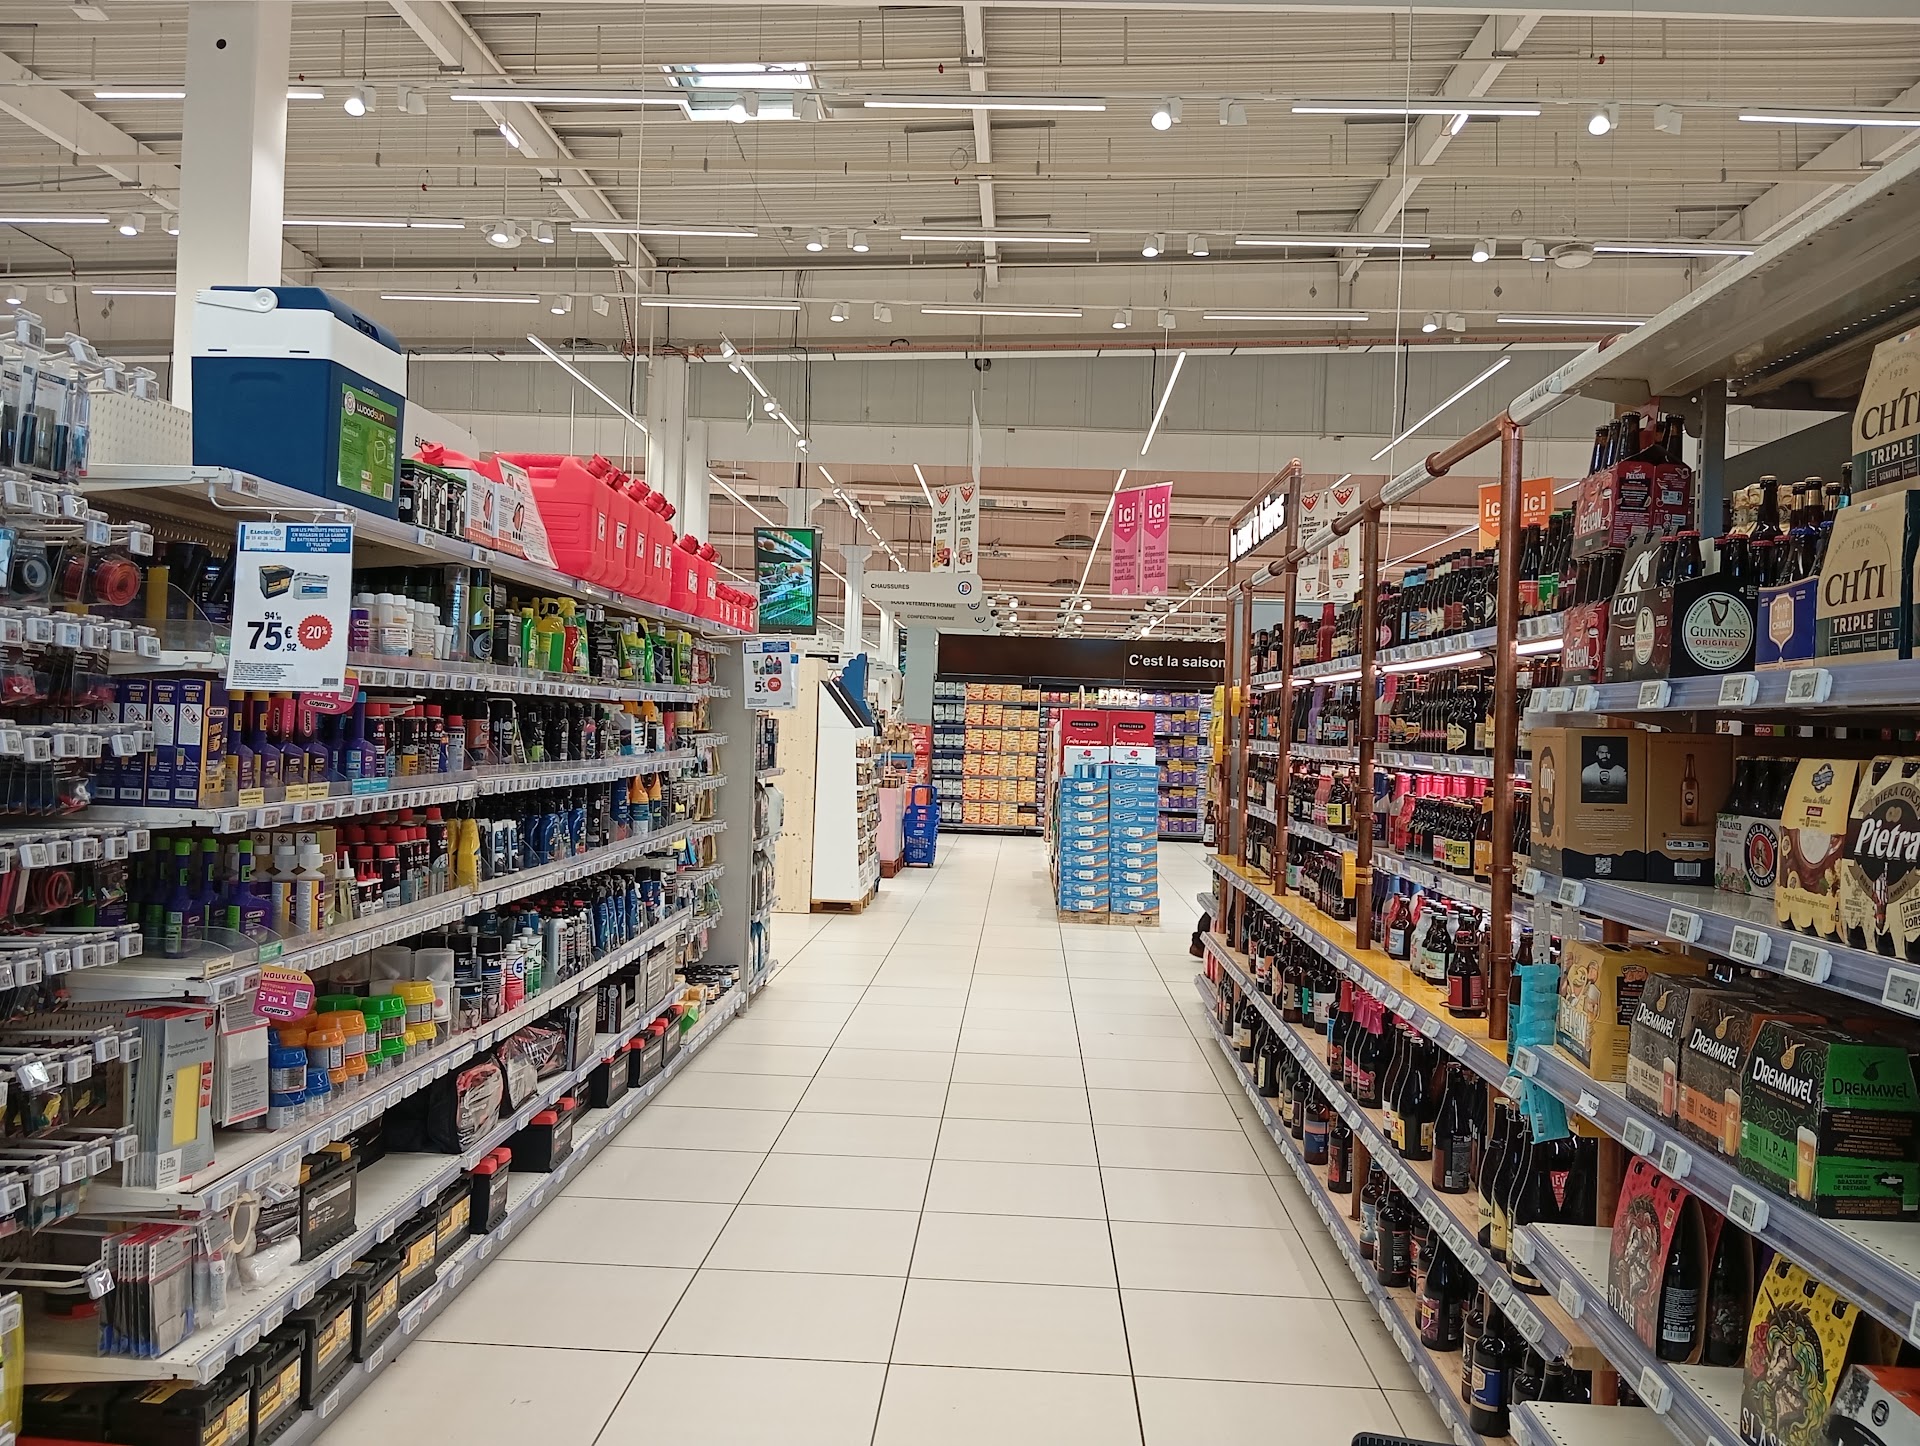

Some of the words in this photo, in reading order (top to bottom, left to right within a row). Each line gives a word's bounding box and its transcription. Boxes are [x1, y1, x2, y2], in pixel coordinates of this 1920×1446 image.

[1889, 364, 1909, 380] 1926
[356, 403, 385, 423] woodsun
[1871, 439, 1914, 467] TRIPLE
[1879, 467, 1901, 482] SIGNATURE
[1149, 498, 1165, 519] ici
[1523, 491, 1547, 513] ici
[1118, 502, 1136, 523] ici
[1851, 537, 1871, 550] 1926
[1690, 625, 1746, 639] GUINNESS
[1833, 612, 1874, 634] TRIPLE
[1695, 639, 1739, 647] ORIGINAL
[1841, 639, 1861, 650] SIGNATURE
[1128, 654, 1164, 667] C'est
[1166, 655, 1179, 667] la
[1182, 656, 1226, 668] saison
[209, 721, 224, 735] FORCE
[1875, 786, 1899, 807] BIERA
[1719, 820, 1742, 831] PAULANER
[1746, 824, 1778, 850] PAULANER
[1854, 817, 1920, 863] Pietra
[1902, 903, 1910, 914] LA
[263, 971, 303, 982] NOUVEAU
[259, 991, 266, 1001] 5
[268, 995, 279, 1004] EN
[280, 996, 288, 1005] 1
[1640, 1066, 1649, 1080] BLÉ
[1700, 1102, 1718, 1122] DORÉE
[367, 1294, 382, 1312] FULMEN
[1609, 1283, 1635, 1330] SLASH
[318, 1328, 334, 1347] FULMEN
[259, 1383, 279, 1406] FULMEN
[202, 1416, 224, 1442] FULMEN
